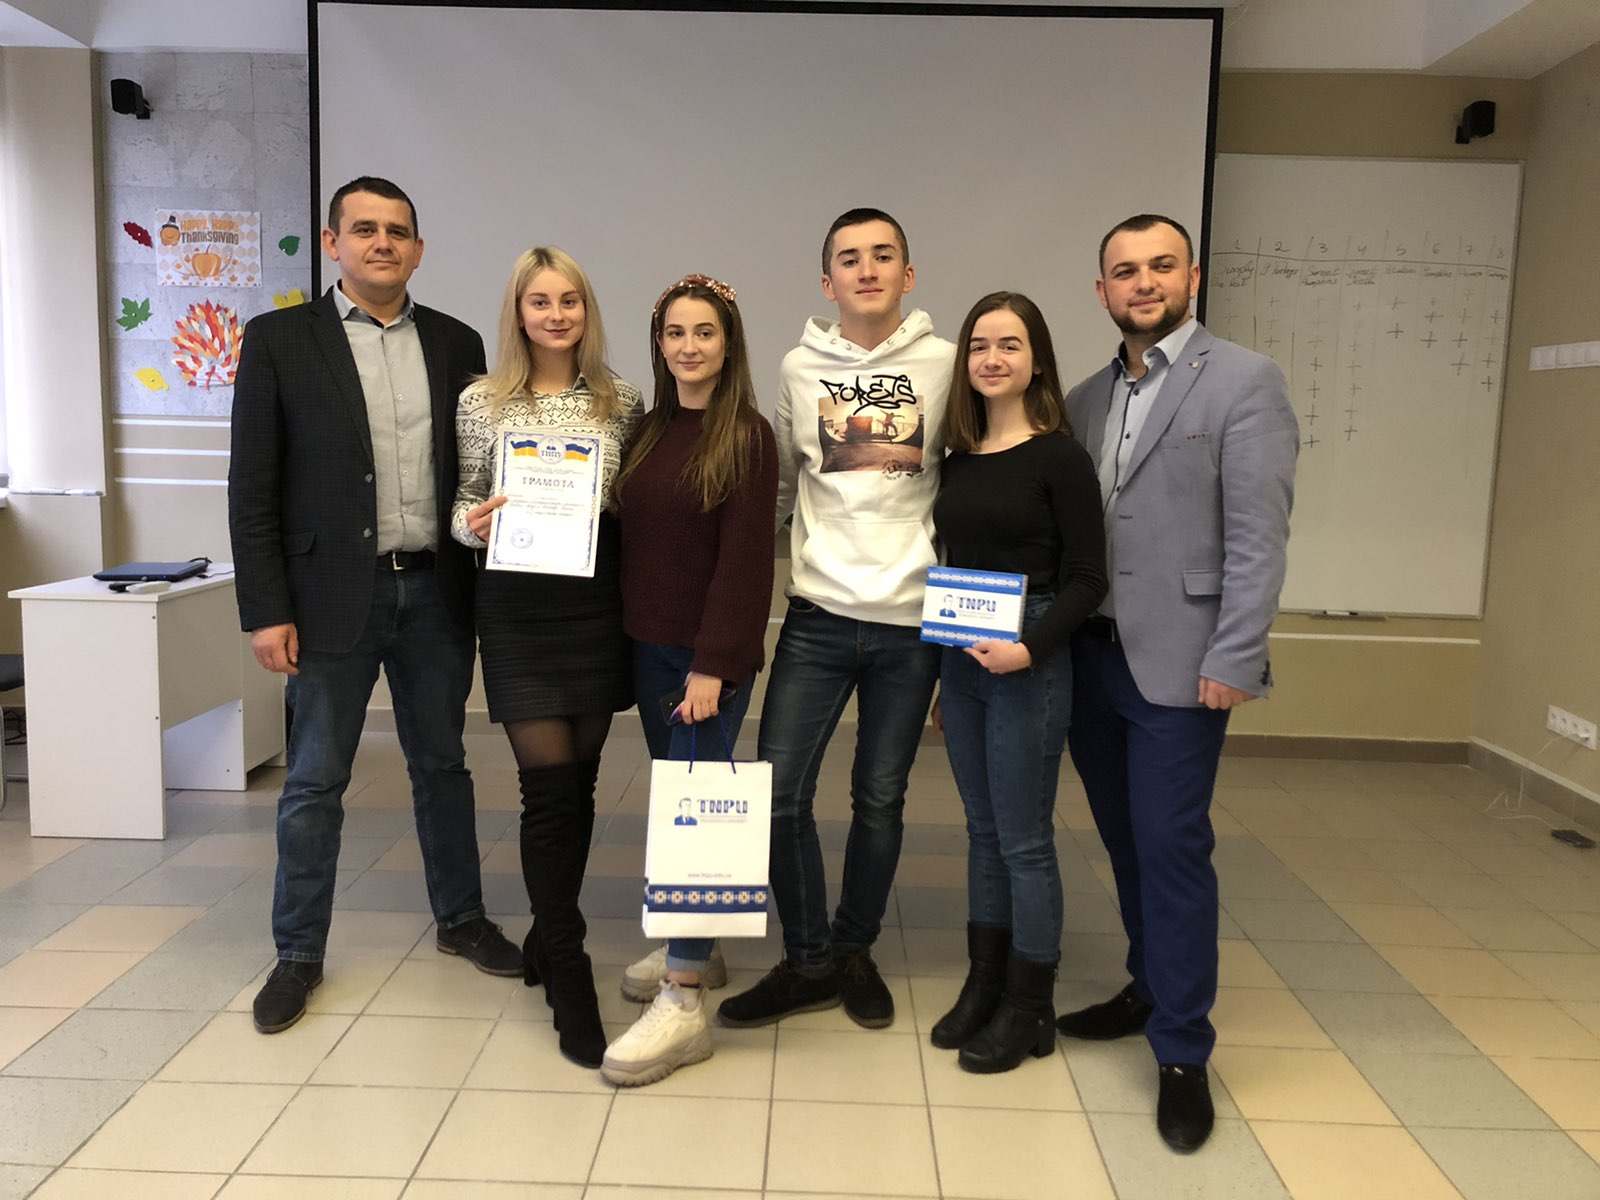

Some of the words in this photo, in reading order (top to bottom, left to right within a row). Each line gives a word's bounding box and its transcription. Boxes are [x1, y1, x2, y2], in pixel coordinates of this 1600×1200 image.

[181, 230, 240, 245] Thanksgiving
[1274, 240, 1291, 252] 2
[1318, 242, 1329, 253] 3
[1357, 244, 1368, 255] 4
[1395, 244, 1407, 256] 5
[1432, 242, 1441, 254] 6
[1466, 244, 1474, 255] 7
[522, 476, 575, 489] ГРАМОТА
[957, 596, 997, 613] TNPU
[696, 799, 748, 814] TNPU
